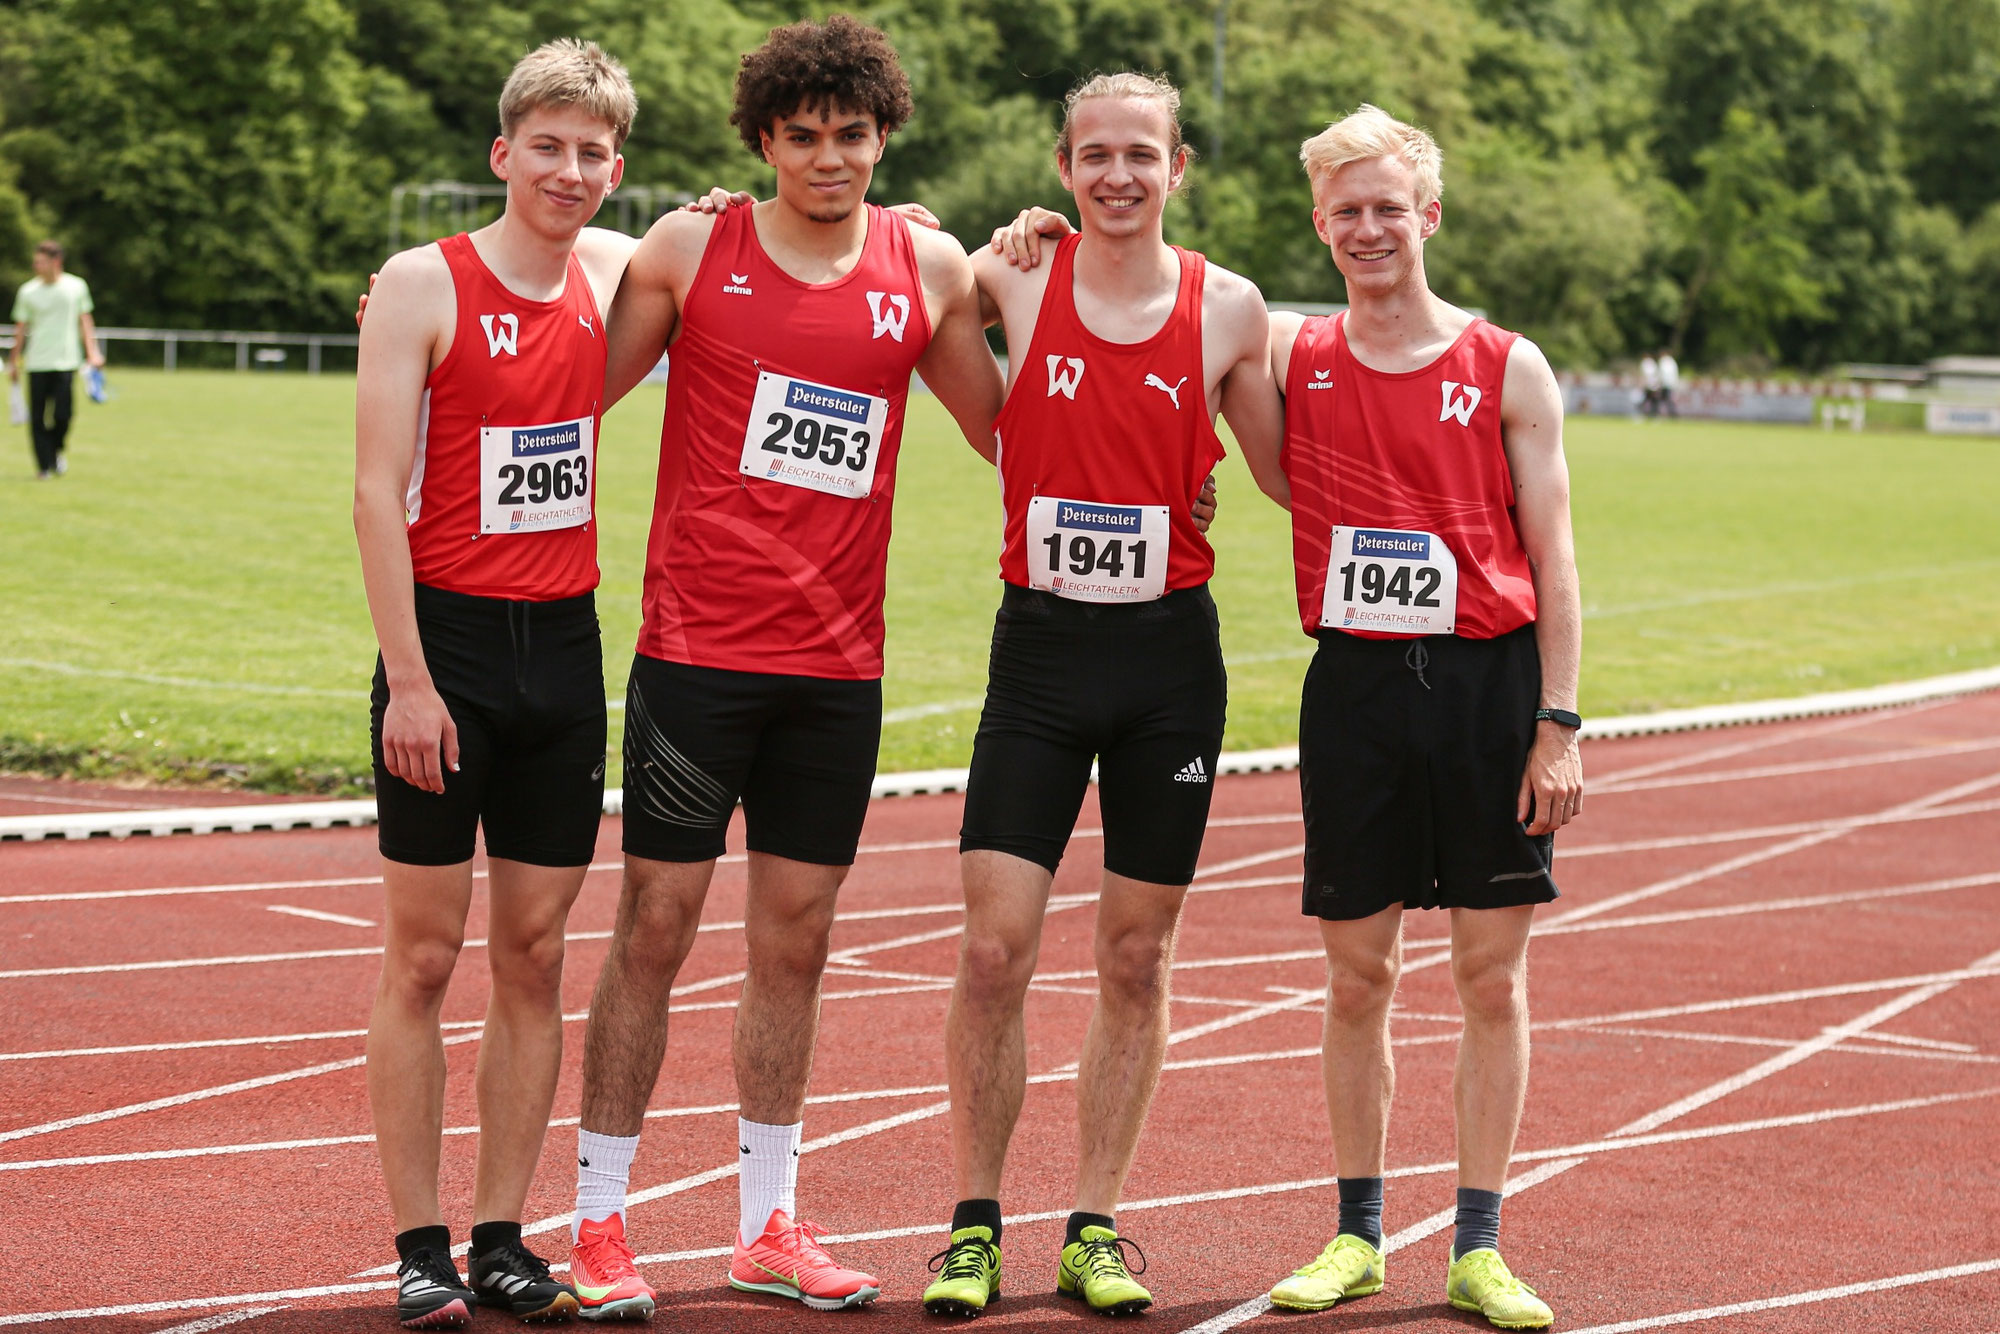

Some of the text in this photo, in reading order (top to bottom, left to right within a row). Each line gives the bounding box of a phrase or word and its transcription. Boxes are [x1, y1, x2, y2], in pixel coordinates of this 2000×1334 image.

[723, 285, 752, 296] erima
[1307, 381, 1333, 390] erima
[792, 387, 865, 415] Peterstaler
[518, 430, 577, 452] Peterstaler
[761, 412, 871, 472] 2953
[498, 455, 588, 505] 2963
[782, 464, 857, 488] LEICHTATHLETIK
[1062, 507, 1136, 526] Peterstaler
[1357, 534, 1425, 552] Peterstaler
[1043, 533, 1147, 578] 1941
[1063, 582, 1141, 594] LEICHTATHLETIK
[1340, 561, 1441, 607] 1942
[1355, 611, 1430, 624] LEICHTATHLETIK
[1174, 772, 1208, 783] adidas
